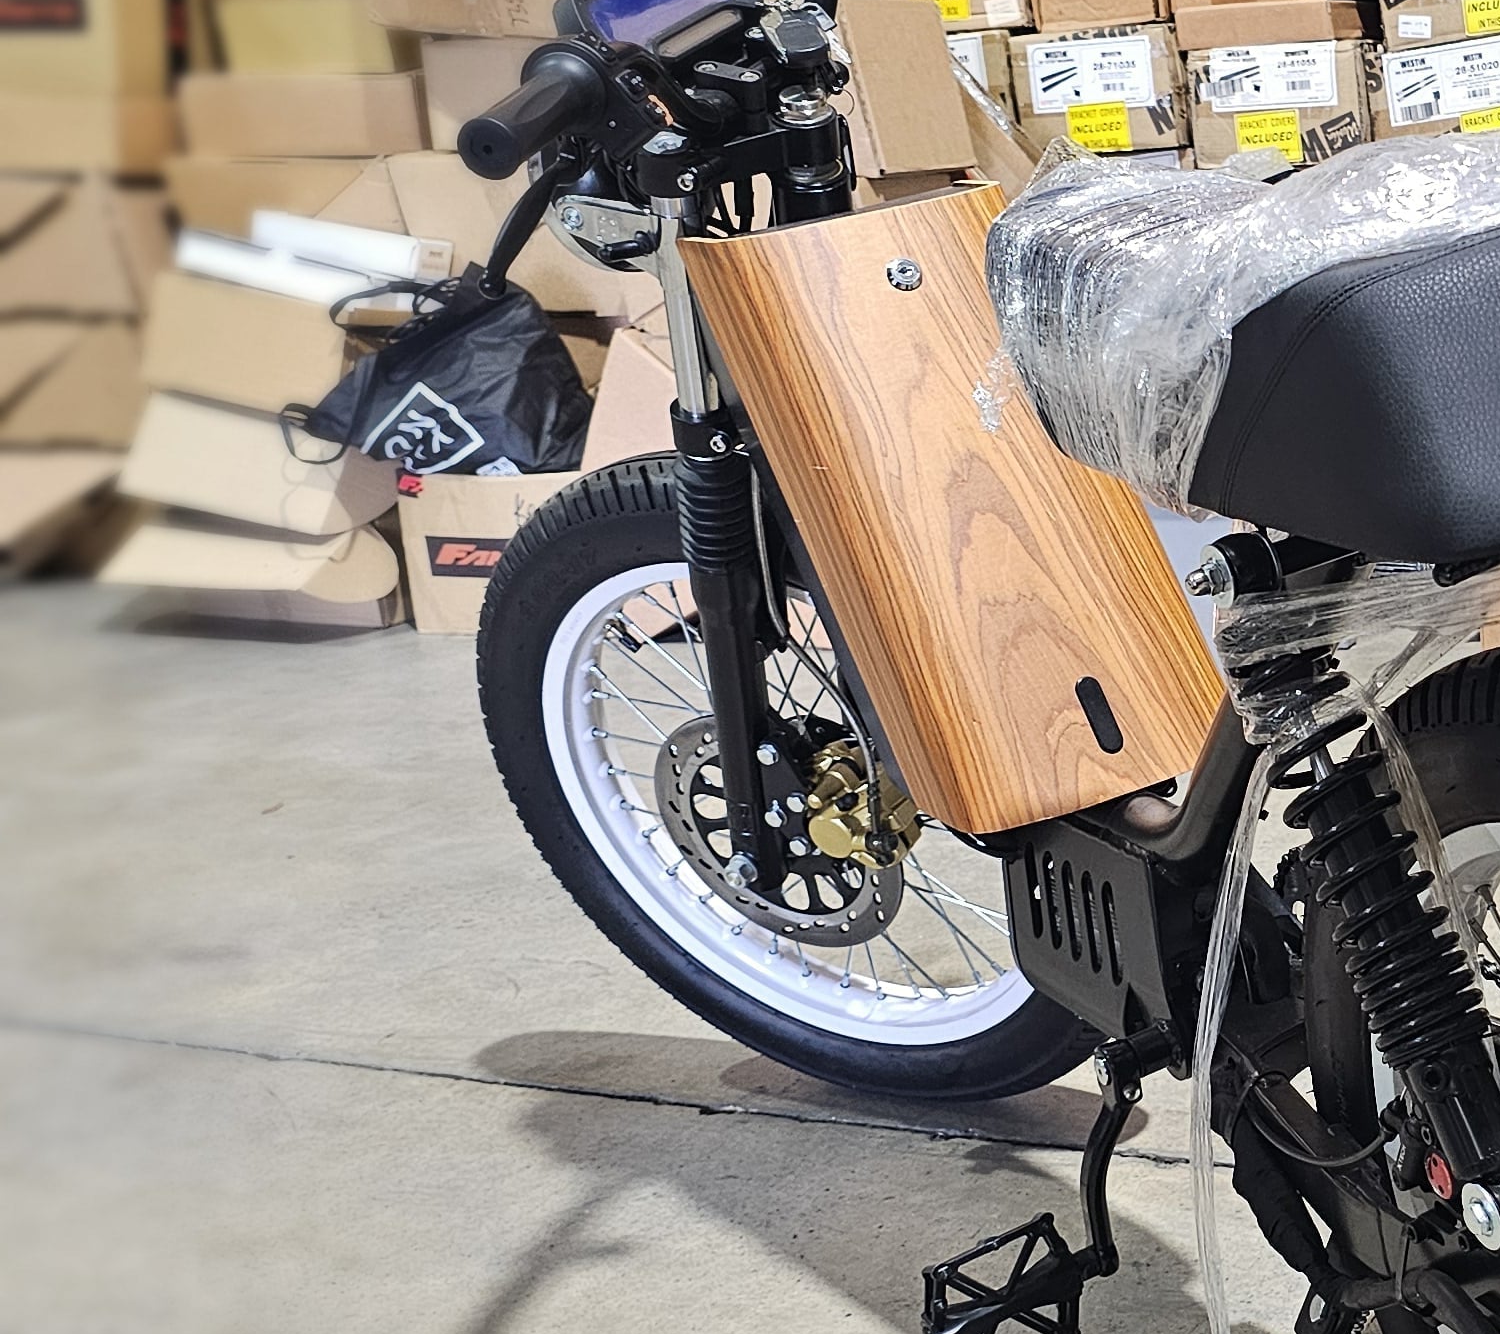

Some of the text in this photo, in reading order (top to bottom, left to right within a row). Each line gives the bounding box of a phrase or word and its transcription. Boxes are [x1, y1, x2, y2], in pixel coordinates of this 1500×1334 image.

[1478, 18, 1486, 28] IN
[1400, 58, 1426, 69] WESTIN
[1455, 60, 1500, 76] 28-51020
[1464, 114, 1493, 127] BRACKET
[1073, 121, 1126, 135] INCLUDED!
[1241, 131, 1297, 145] INCLUDED!
